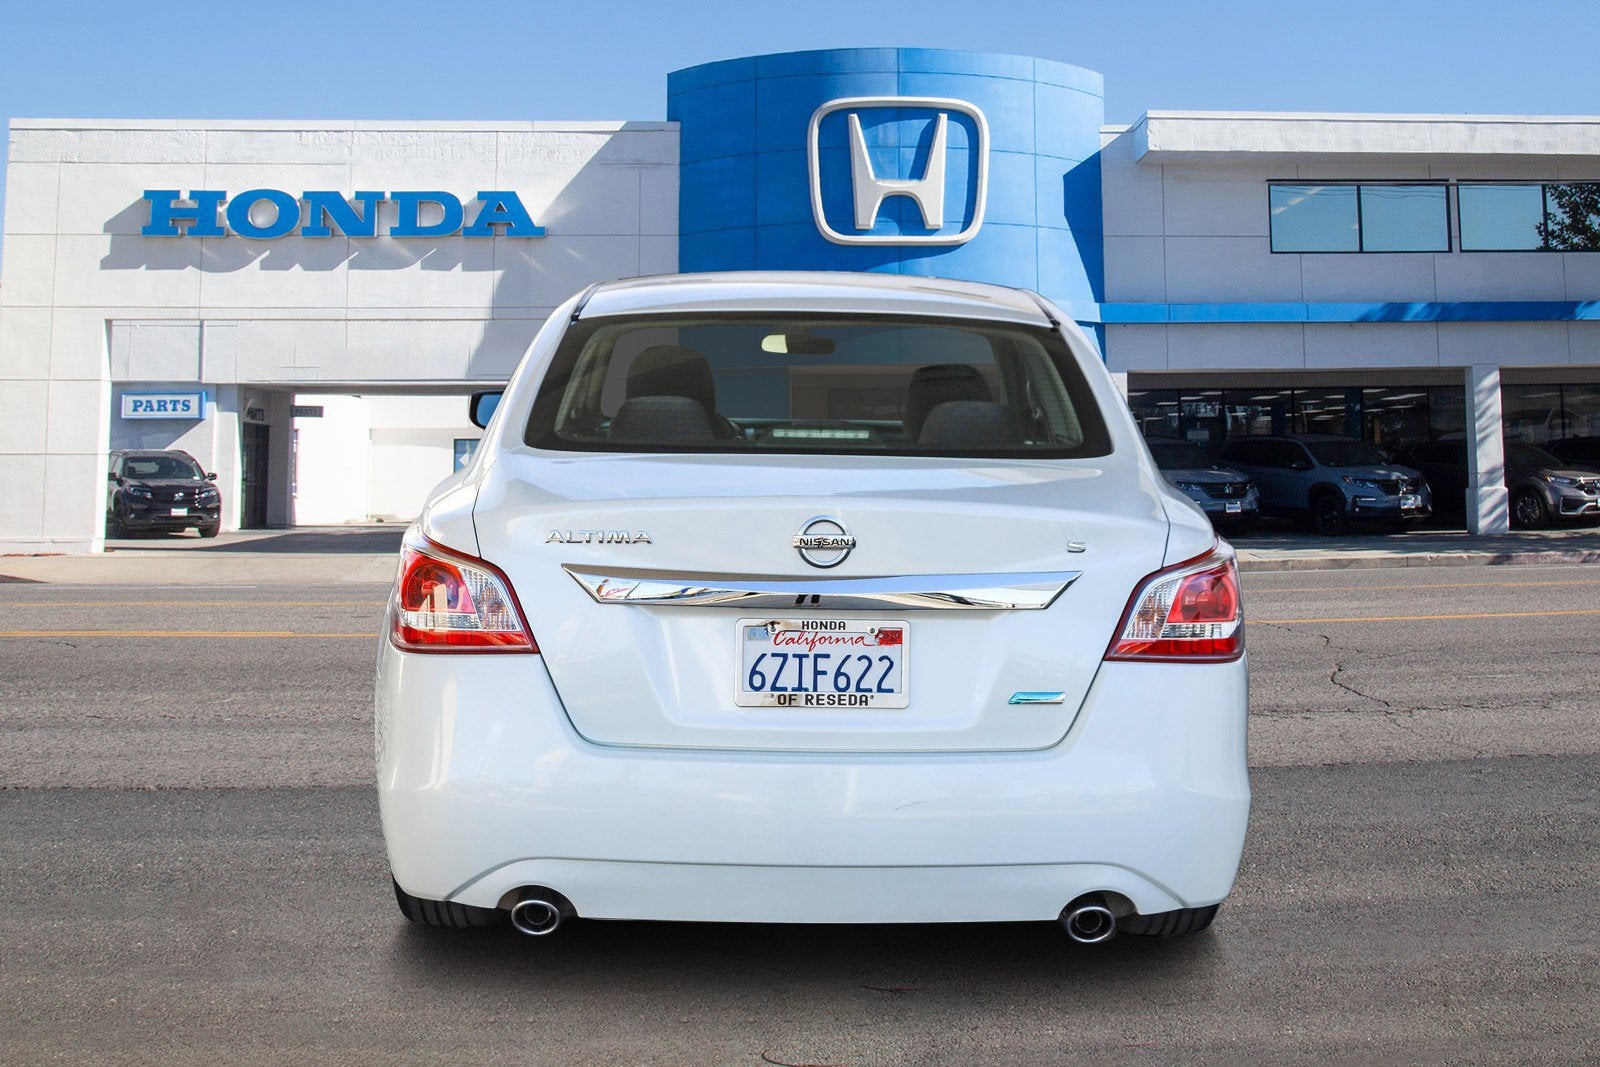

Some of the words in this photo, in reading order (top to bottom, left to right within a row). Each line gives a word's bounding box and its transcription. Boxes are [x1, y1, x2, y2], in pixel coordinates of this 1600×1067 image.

[849, 113, 947, 229] H
[142, 189, 547, 239] HONDA
[132, 399, 191, 412] PARTS
[545, 529, 652, 544] ALTIMA
[799, 536, 850, 547] NISSAN
[1067, 541, 1086, 553] S
[801, 620, 846, 631] HONDA
[773, 630, 873, 653] California
[748, 653, 894, 693] 6ZIF622
[777, 694, 797, 706] OF
[804, 694, 869, 706] RESEDA
